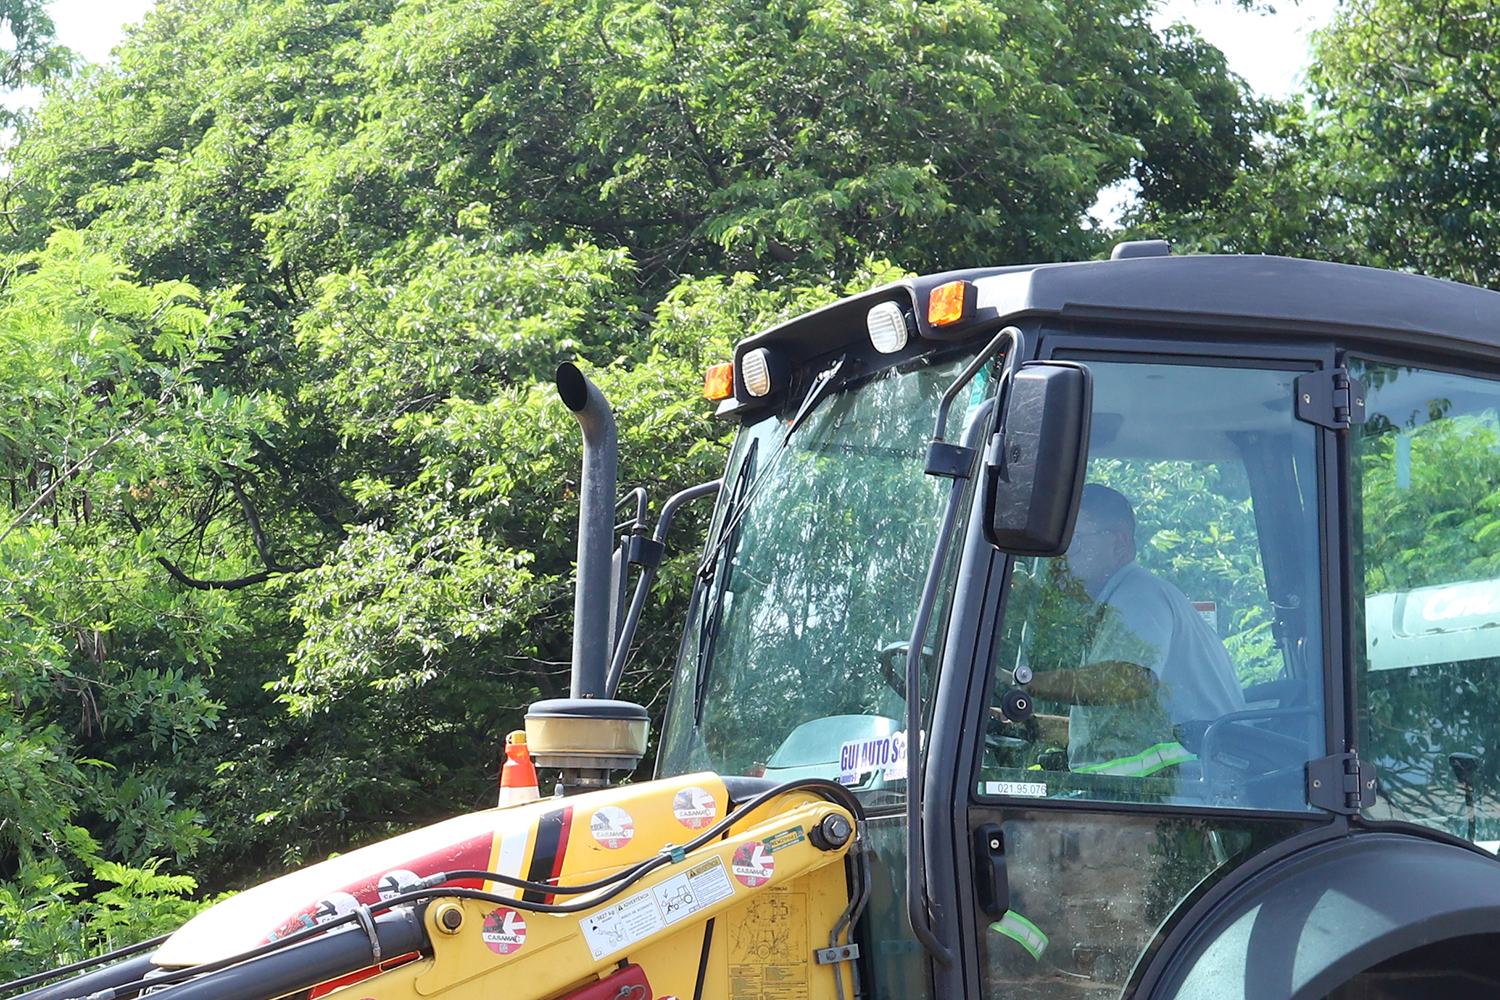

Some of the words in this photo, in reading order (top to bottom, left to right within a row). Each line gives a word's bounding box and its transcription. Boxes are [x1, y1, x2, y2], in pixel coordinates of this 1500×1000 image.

[840, 743, 860, 772] GUI
[861, 738, 890, 767] AUTO
[997, 783, 1047, 795] 021.95.076
[736, 867, 769, 877] CASAMAC
[487, 934, 521, 943] CASAMAC
